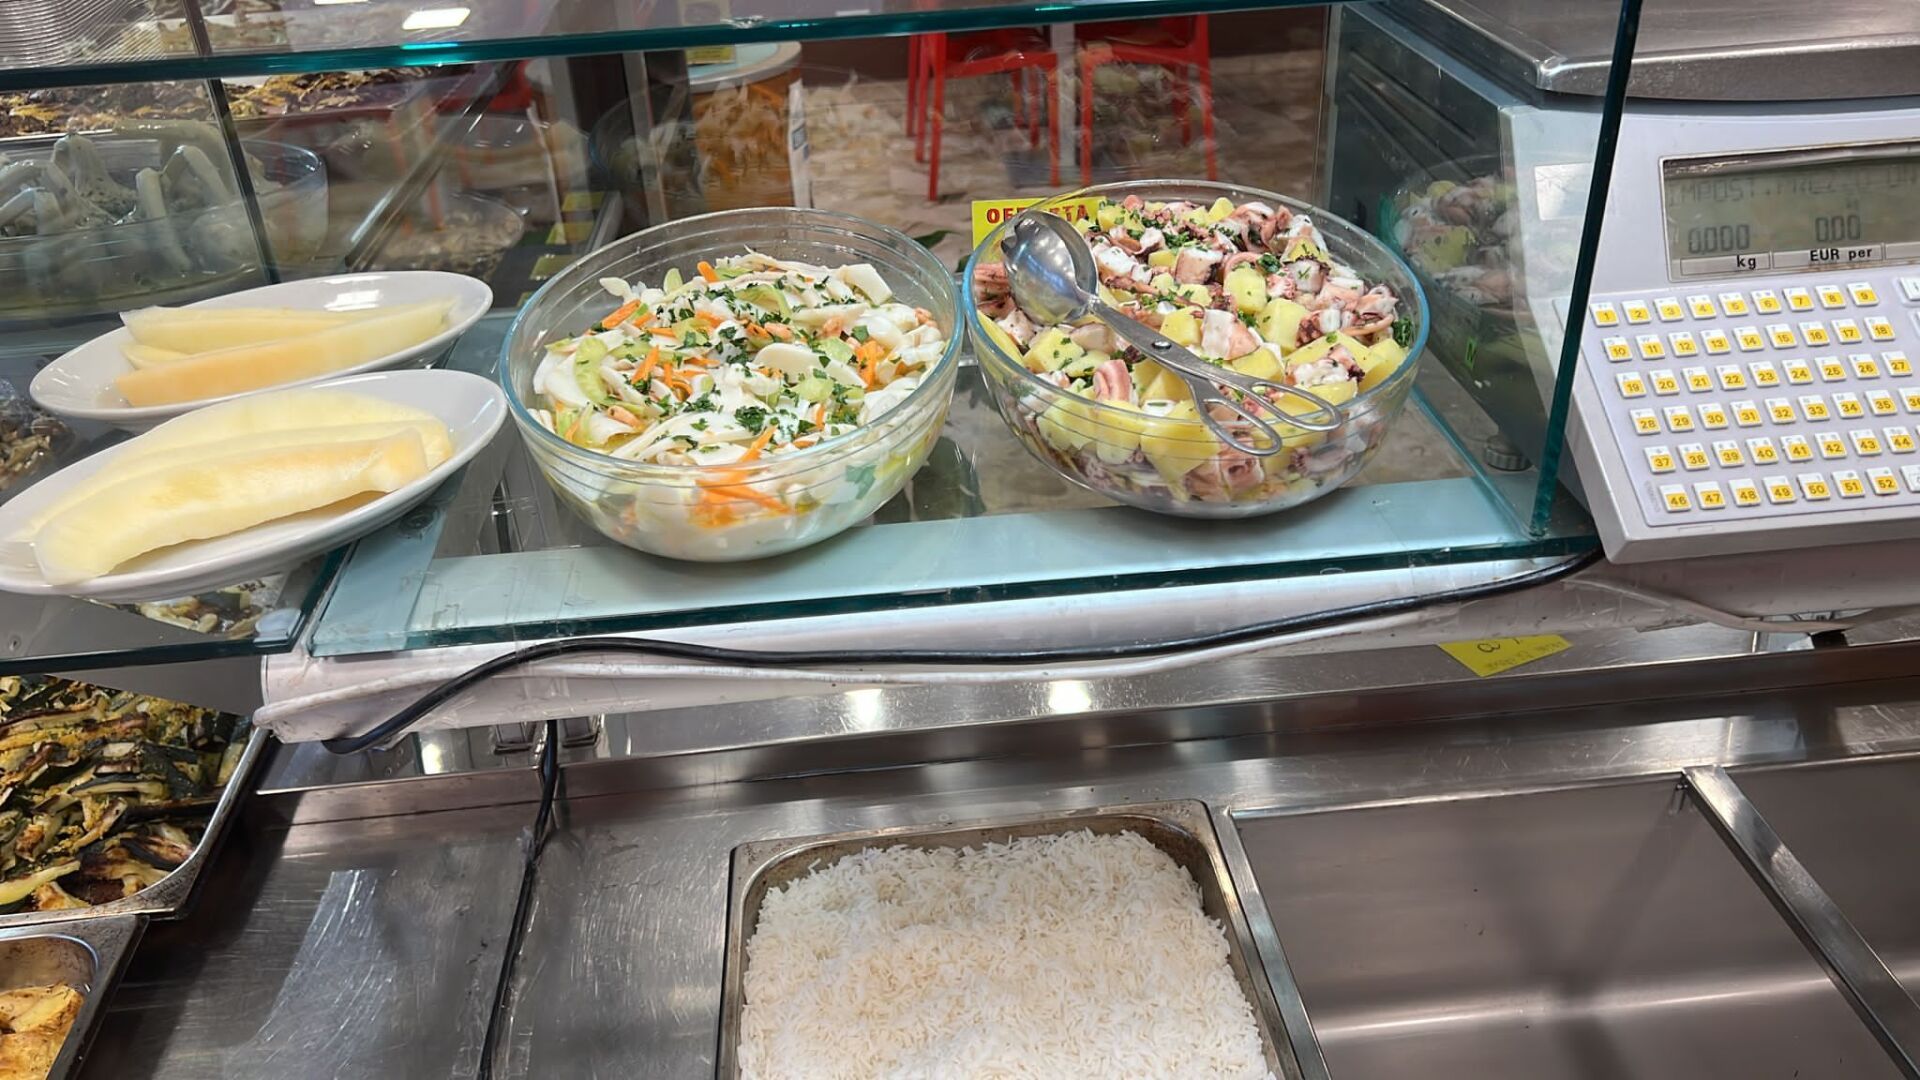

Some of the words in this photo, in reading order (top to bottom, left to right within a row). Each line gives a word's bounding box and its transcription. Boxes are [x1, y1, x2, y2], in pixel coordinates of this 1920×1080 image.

[986, 203, 1088, 224] OFTA
[1736, 255, 1757, 269] kg
[1810, 248, 1840, 262] EUR
[1848, 248, 1873, 261] per
[1613, 347, 1626, 356] 10
[1647, 344, 1658, 353] 11
[1678, 342, 1691, 351] 12
[1710, 339, 1724, 348] 13
[1744, 336, 1757, 346] 14
[1777, 334, 1790, 343] 15
[1810, 331, 1823, 340] 16
[1841, 329, 1855, 338] 17
[1875, 326, 1888, 335] 18
[1627, 383, 1640, 392] 19
[1661, 380, 1675, 389] 20
[1693, 377, 1707, 386] 21
[1725, 374, 1741, 384] 22
[1758, 372, 1775, 381] 23
[1792, 370, 1808, 379] 24
[1827, 367, 1841, 376] 25
[1859, 364, 1874, 373] 26
[1892, 361, 1905, 370] 27
[1640, 419, 1655, 428] 28
[1674, 417, 1689, 426] 29
[1709, 414, 1724, 424] 30
[1741, 411, 1756, 421] 31
[1776, 408, 1790, 418] 32
[1808, 406, 1824, 415] 33
[1842, 403, 1858, 412] 34
[1876, 400, 1891, 409] 35
[1655, 457, 1670, 467] 37
[1689, 454, 1705, 464] 38
[1724, 452, 1739, 461] 39
[1758, 449, 1774, 458] 40
[1792, 446, 1807, 456] 41
[1826, 444, 1842, 453] 42
[1861, 440, 1876, 449] 43
[1894, 437, 1911, 447] 44
[1670, 496, 1687, 505] 46
[1705, 493, 1720, 503] 47
[1740, 490, 1756, 500] 48
[1774, 487, 1791, 497] 49
[1808, 484, 1825, 495] 50
[1844, 482, 1859, 492] 51
[1878, 479, 1893, 489] 52
